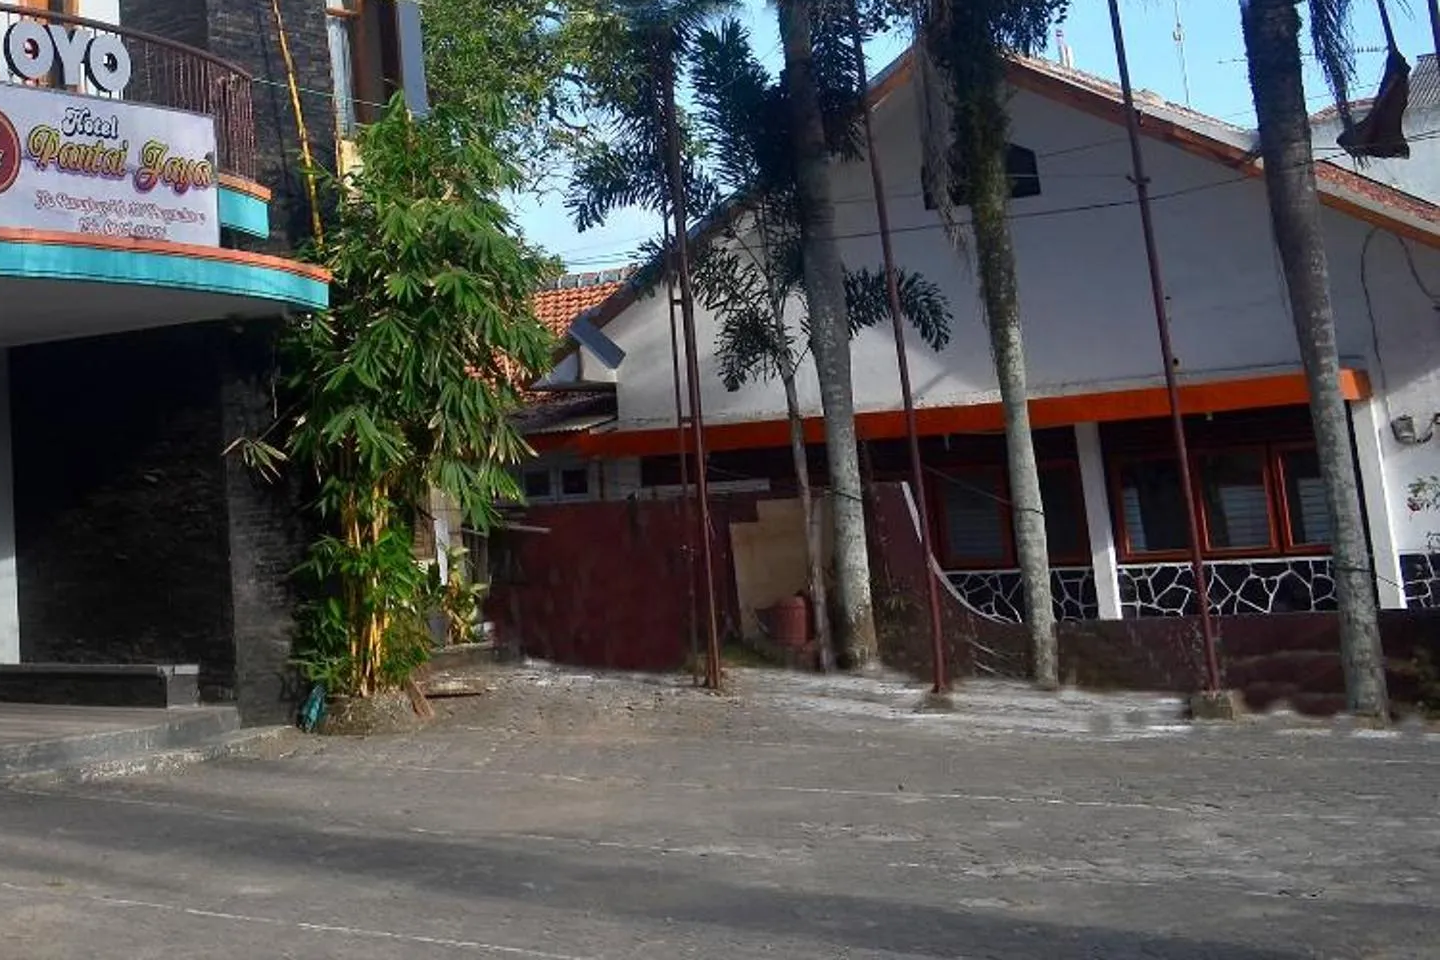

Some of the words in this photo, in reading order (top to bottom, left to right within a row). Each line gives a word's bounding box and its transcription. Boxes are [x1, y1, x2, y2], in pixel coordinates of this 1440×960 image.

[6, 20, 132, 91] OYO
[62, 107, 118, 139] Hotel
[28, 125, 128, 179] Pantai
[134, 140, 212, 194] Jaya
